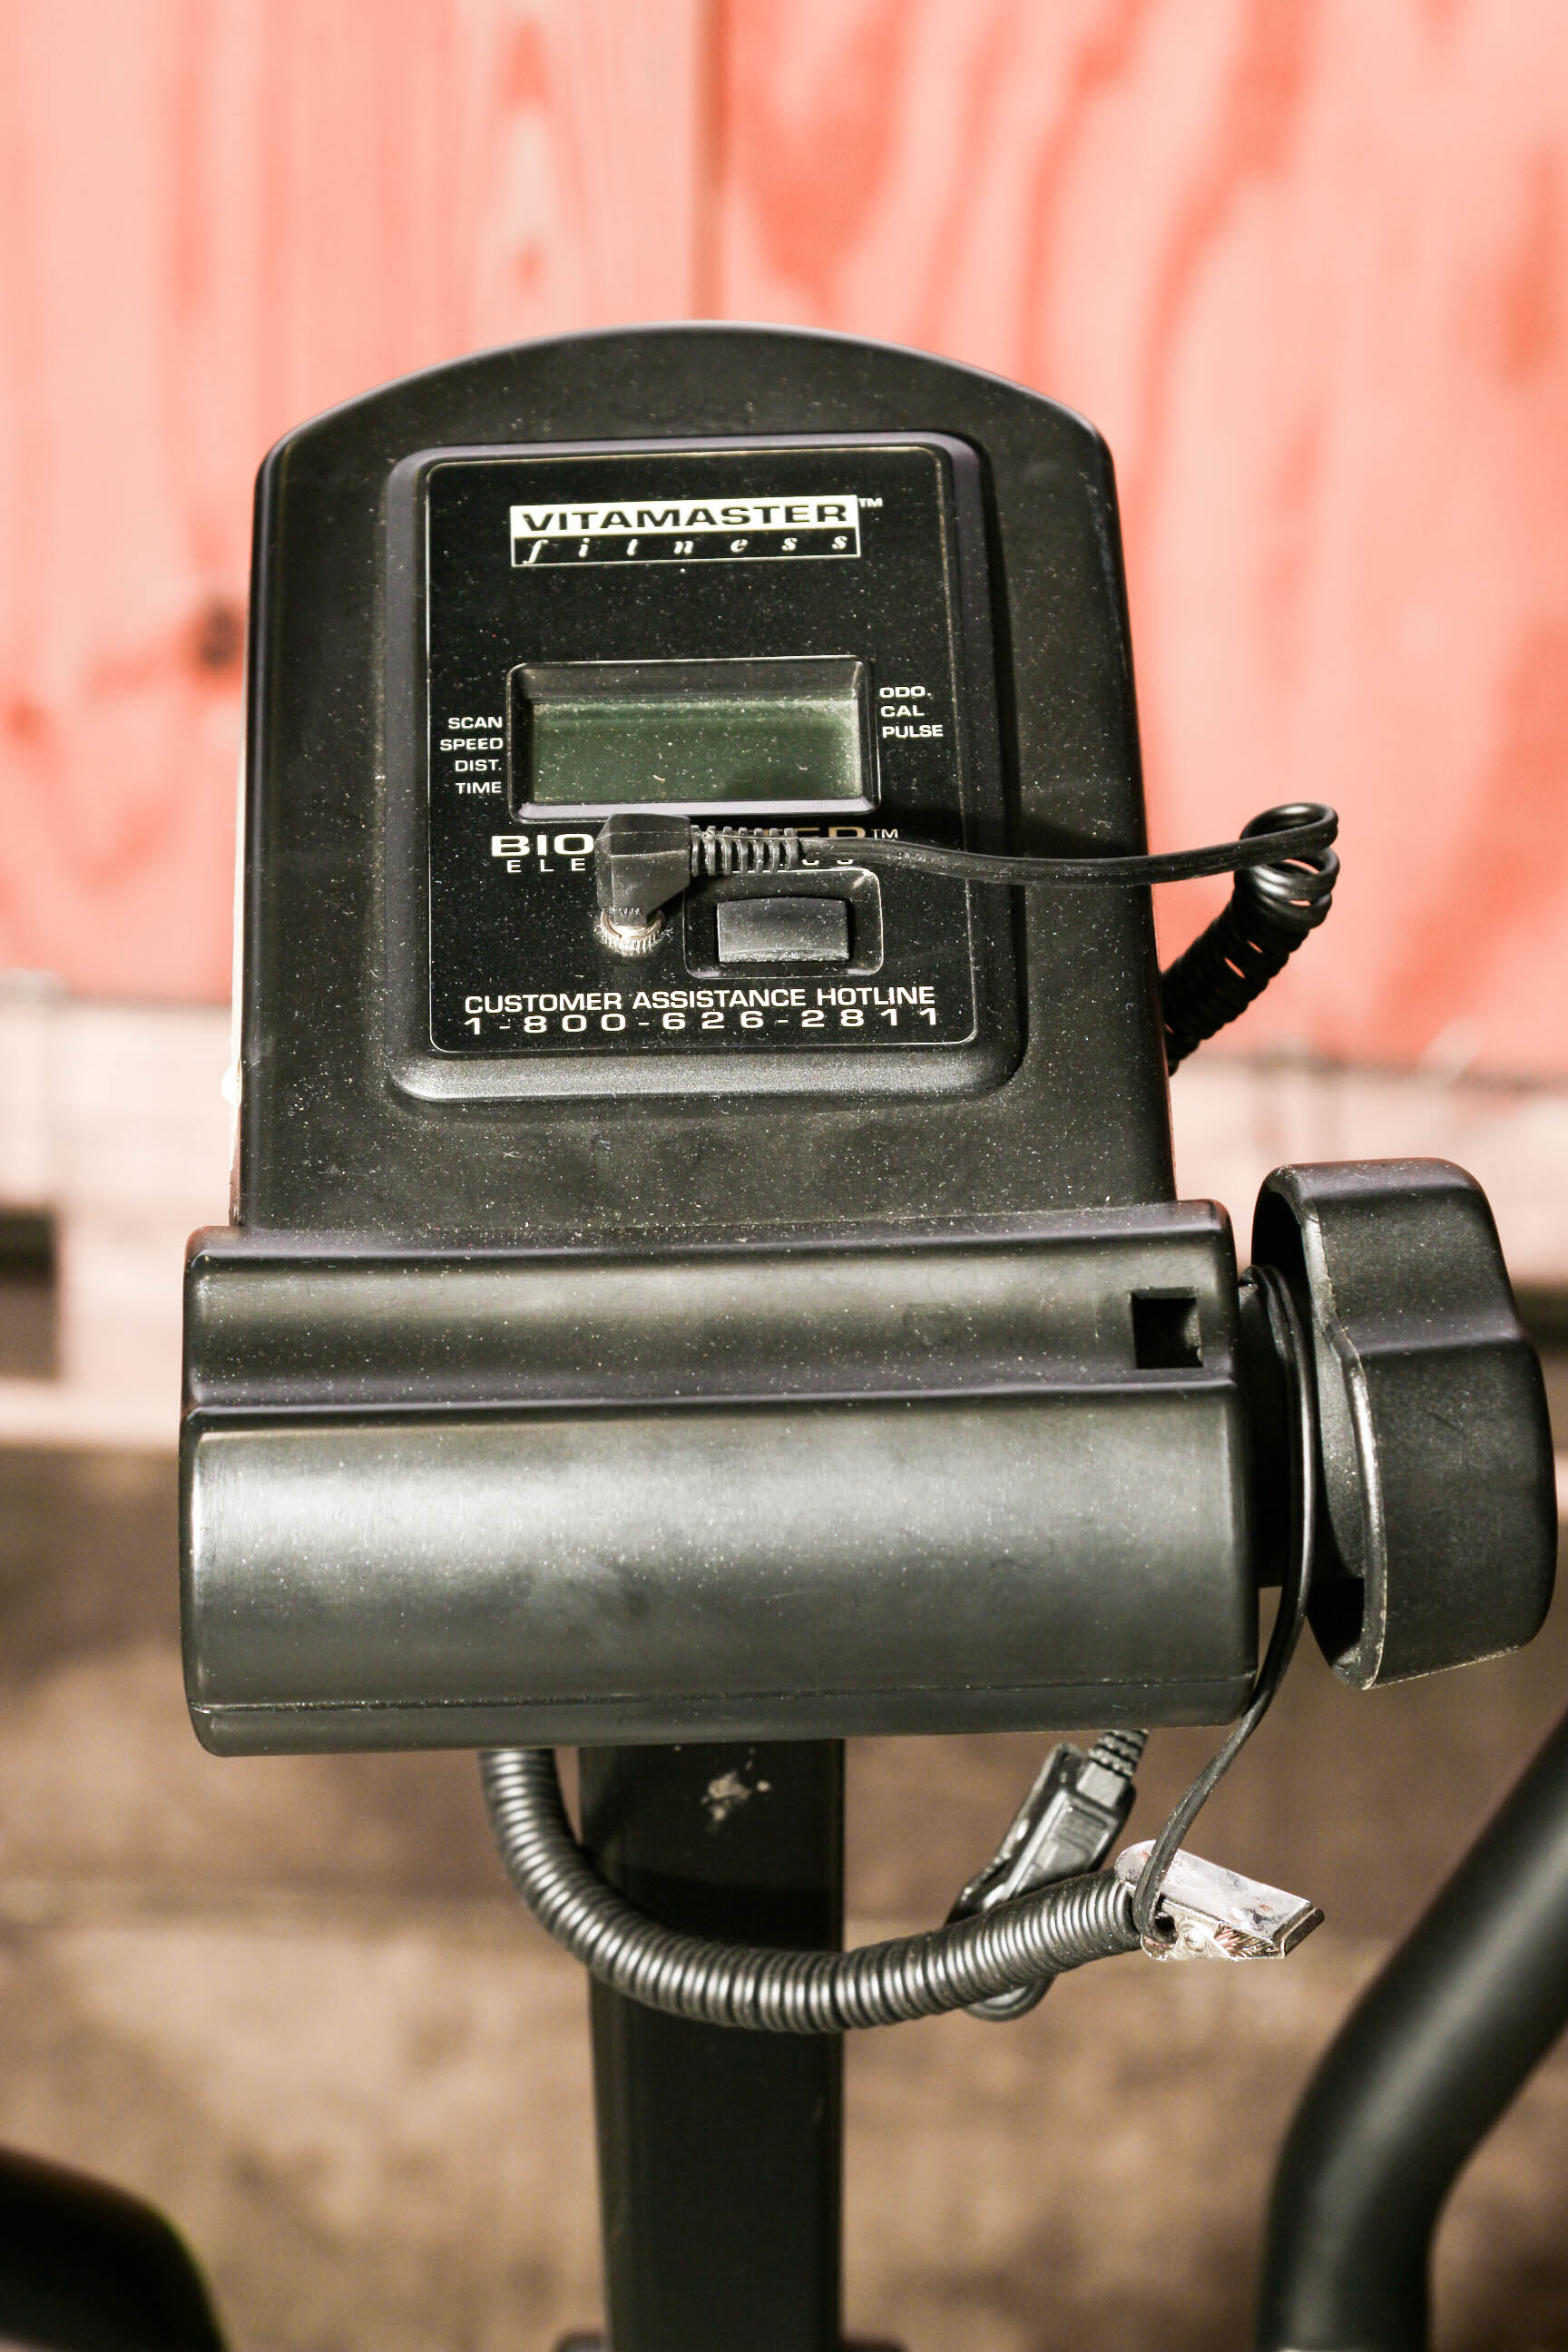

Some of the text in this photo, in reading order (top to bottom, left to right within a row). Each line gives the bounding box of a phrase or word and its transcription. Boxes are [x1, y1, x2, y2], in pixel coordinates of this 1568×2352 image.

[523, 504, 848, 532] VITAMASTER
[523, 534, 848, 564] fitness
[879, 686, 931, 698] ODO.
[880, 705, 925, 718] CAL
[447, 716, 503, 730] SCAN
[882, 724, 944, 739] PULSE
[440, 737, 504, 751] SPEED
[455, 759, 502, 772] DIST.
[456, 781, 502, 794] TIME
[465, 985, 936, 1014] CUSTOMER ASSISTANCE HOTLINE
[464, 1007, 936, 1035] 1-800-626-2811
